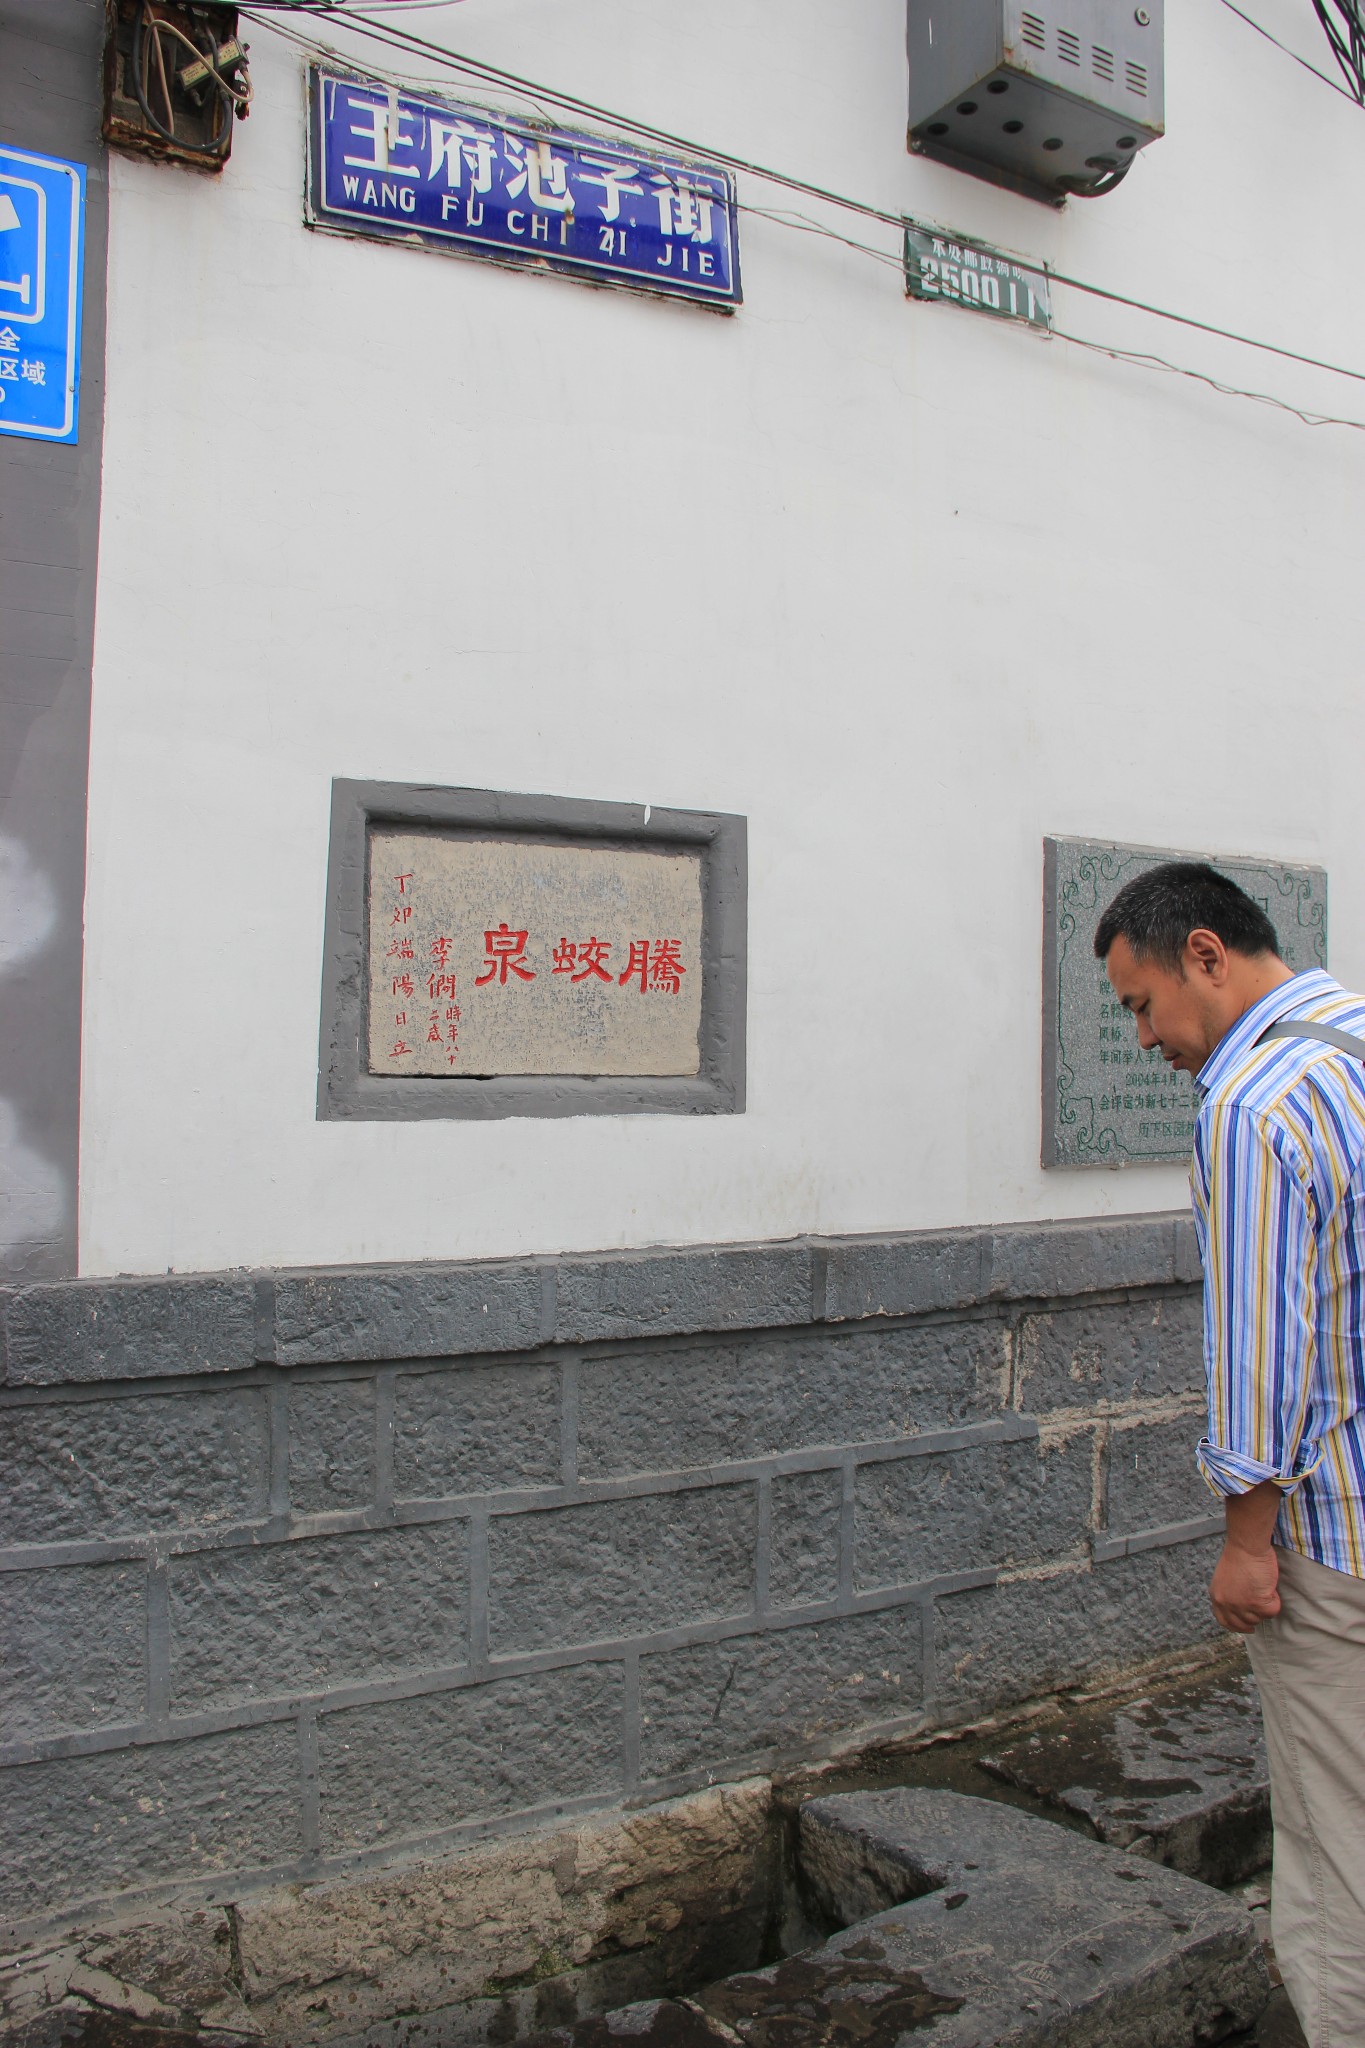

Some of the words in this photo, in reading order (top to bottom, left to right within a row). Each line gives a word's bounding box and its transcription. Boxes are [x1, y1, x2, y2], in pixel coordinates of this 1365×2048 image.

[343, 97, 714, 244] 王府池子街
[342, 175, 416, 213] WANG
[441, 193, 485, 228] FU
[506, 209, 568, 246] CHI
[656, 243, 716, 277] JIE
[919, 256, 1036, 320] 250011
